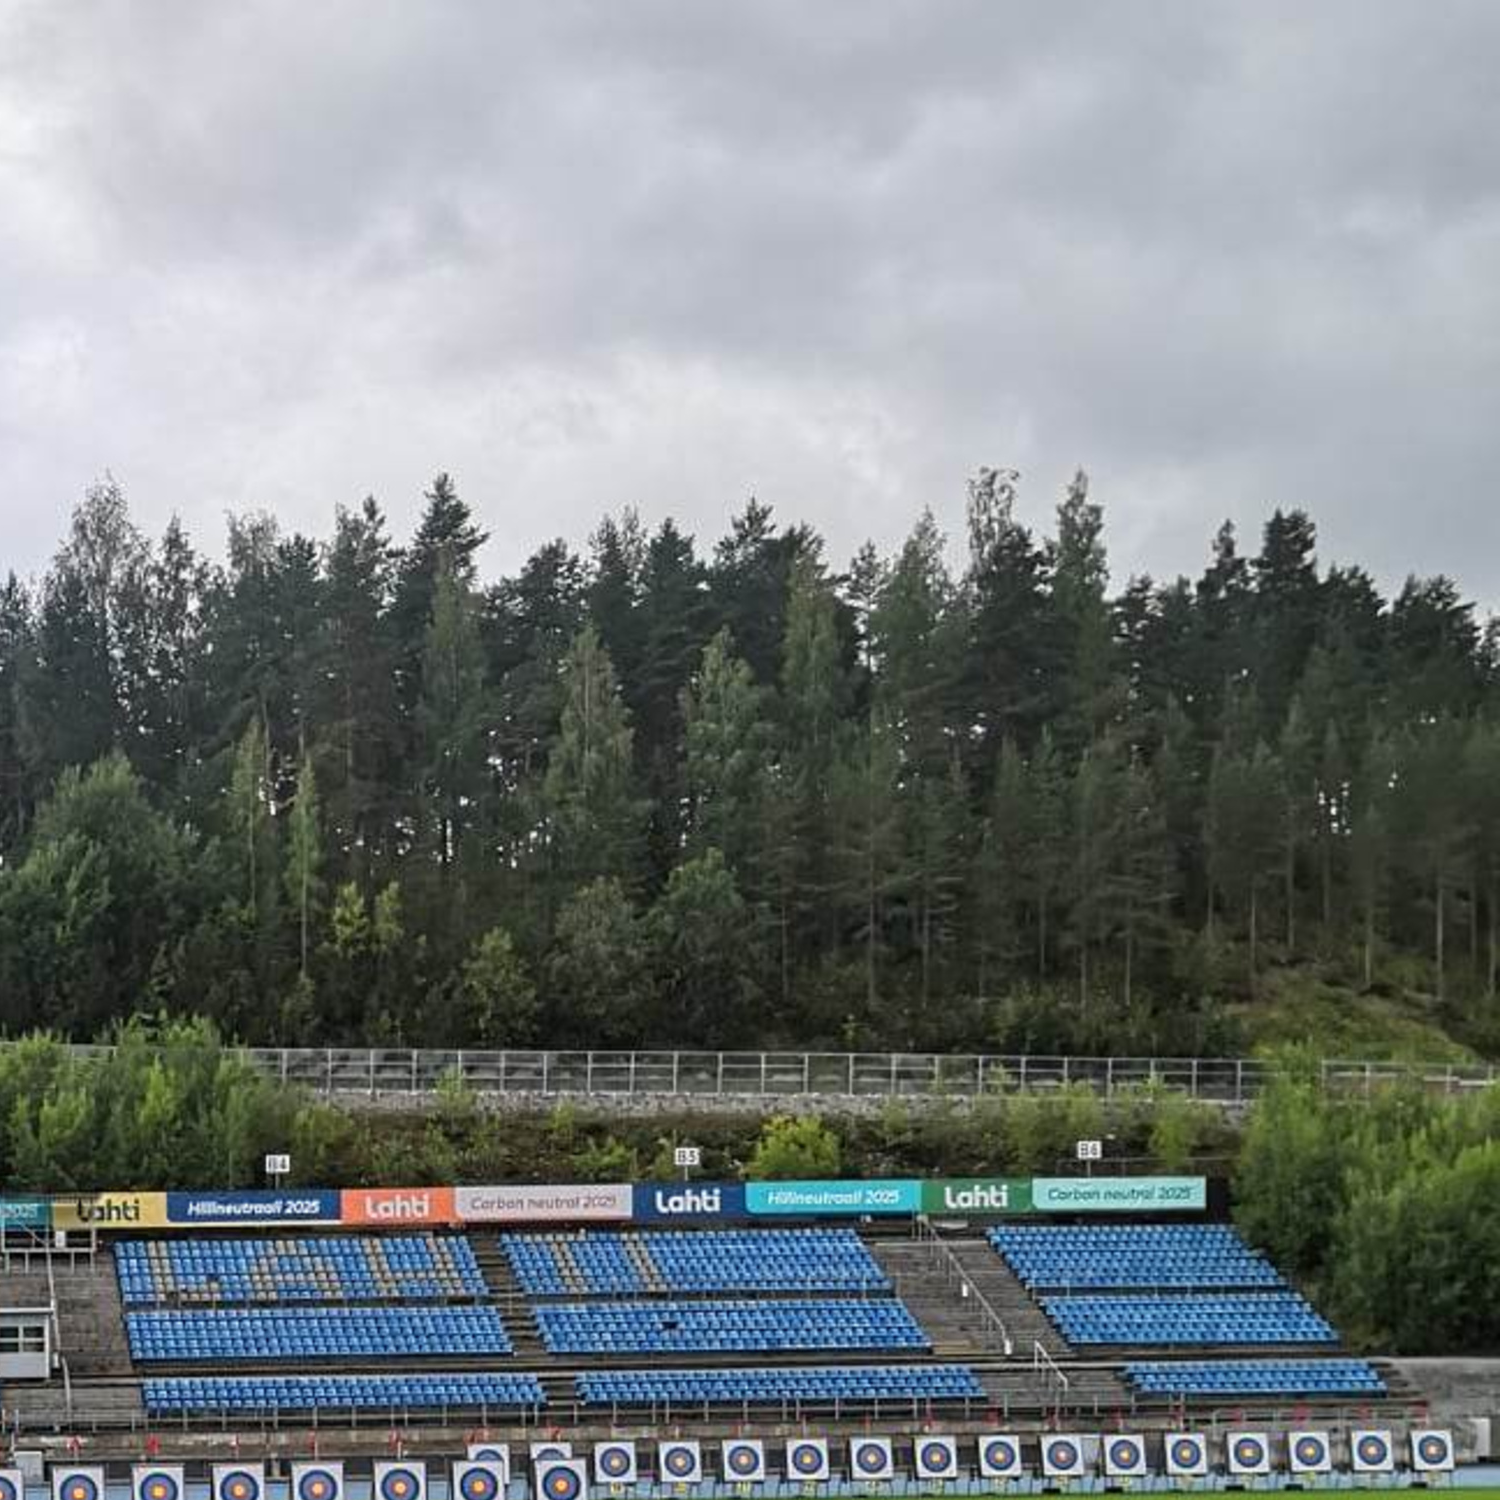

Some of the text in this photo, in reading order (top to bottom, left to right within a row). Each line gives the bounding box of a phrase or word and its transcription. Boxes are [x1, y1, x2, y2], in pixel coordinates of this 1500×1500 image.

[470, 1194, 617, 1210] Carbon neutral 2025
[655, 1188, 721, 1213] Lahti
[865, 1190, 900, 1204] 2025
[944, 1185, 1008, 1209] Lahti
[1048, 1186, 1192, 1201] Carbon neutral 2025
[76, 1197, 140, 1222] Lahti
[285, 1200, 321, 1214] 2025
[365, 1194, 429, 1219] Lahti
